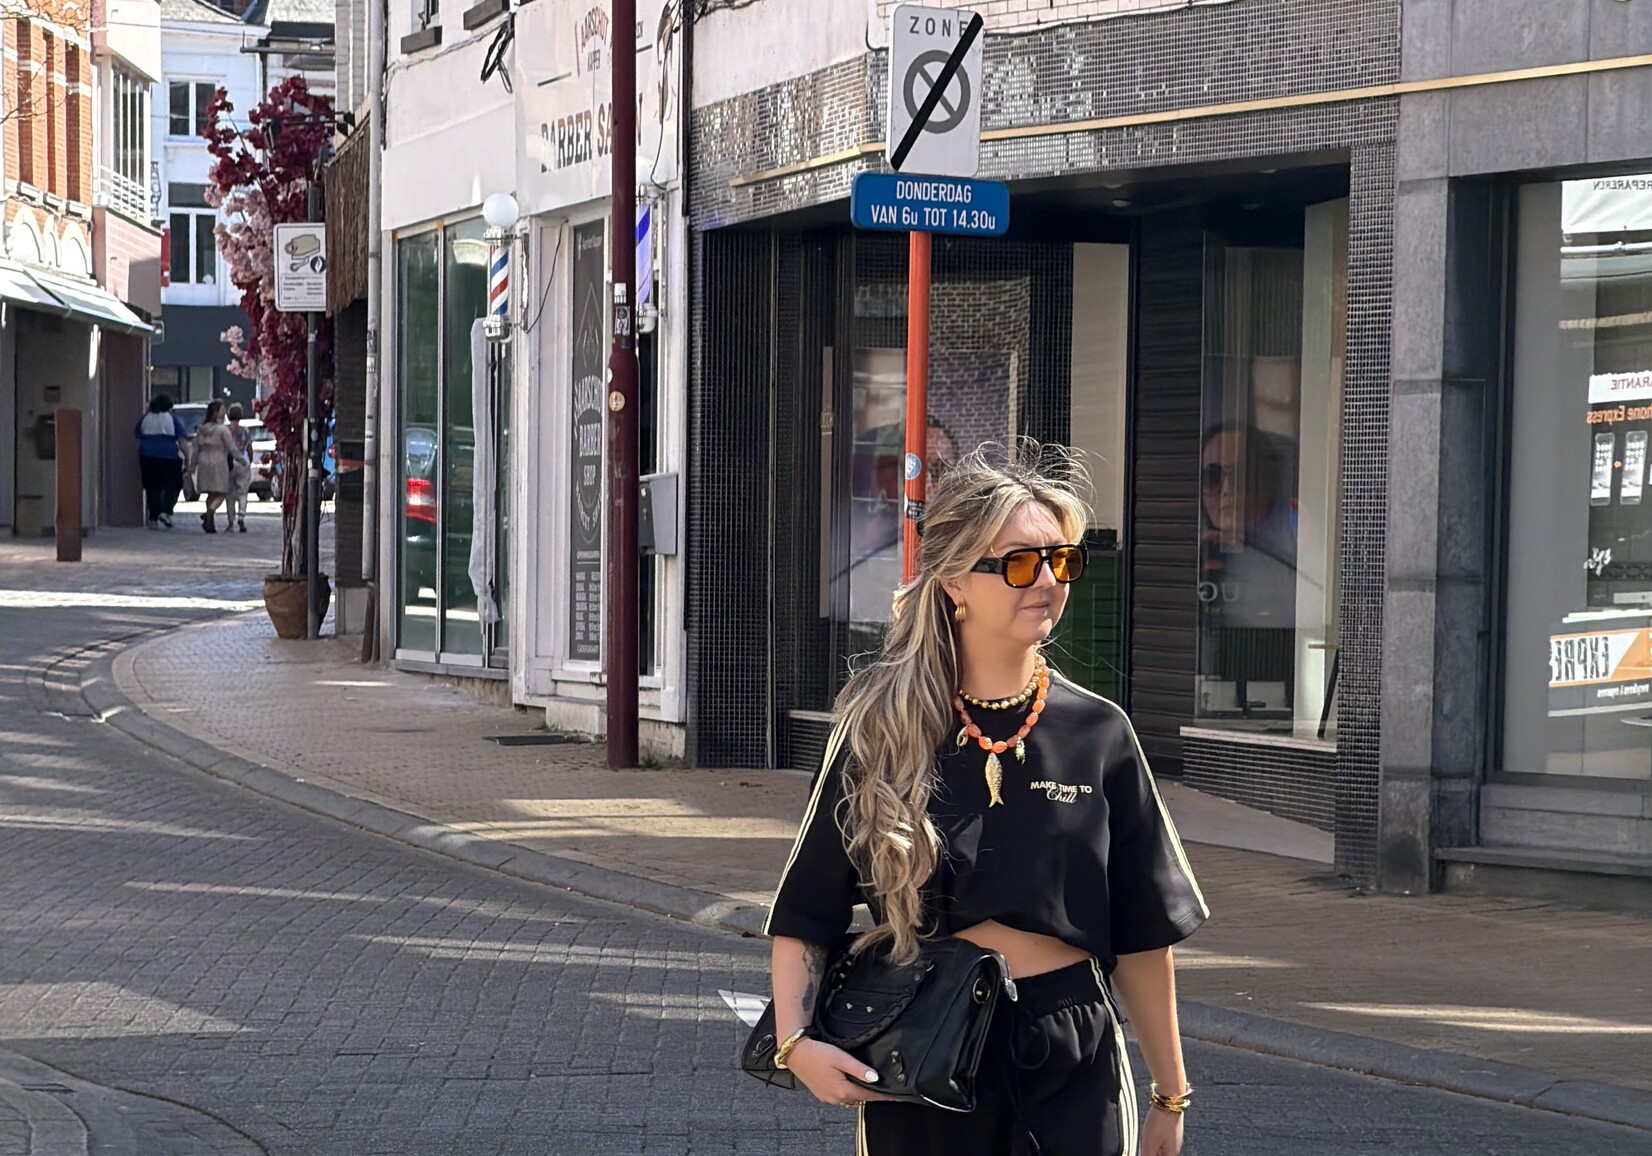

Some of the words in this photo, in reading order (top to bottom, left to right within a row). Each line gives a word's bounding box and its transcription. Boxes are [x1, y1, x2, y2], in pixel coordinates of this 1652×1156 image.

[909, 16, 969, 37] ZONE
[597, 92, 643, 157] SAN
[896, 180, 972, 203] DONDERDAG
[871, 205, 897, 224] VAN
[902, 206, 918, 225] 6u
[923, 207, 947, 226] TOT
[952, 209, 996, 230] 14.30u
[1030, 781, 1057, 790] MAKE
[1058, 783, 1077, 793] TIME
[1079, 785, 1093, 793] TO
[1046, 787, 1078, 804] Chill
